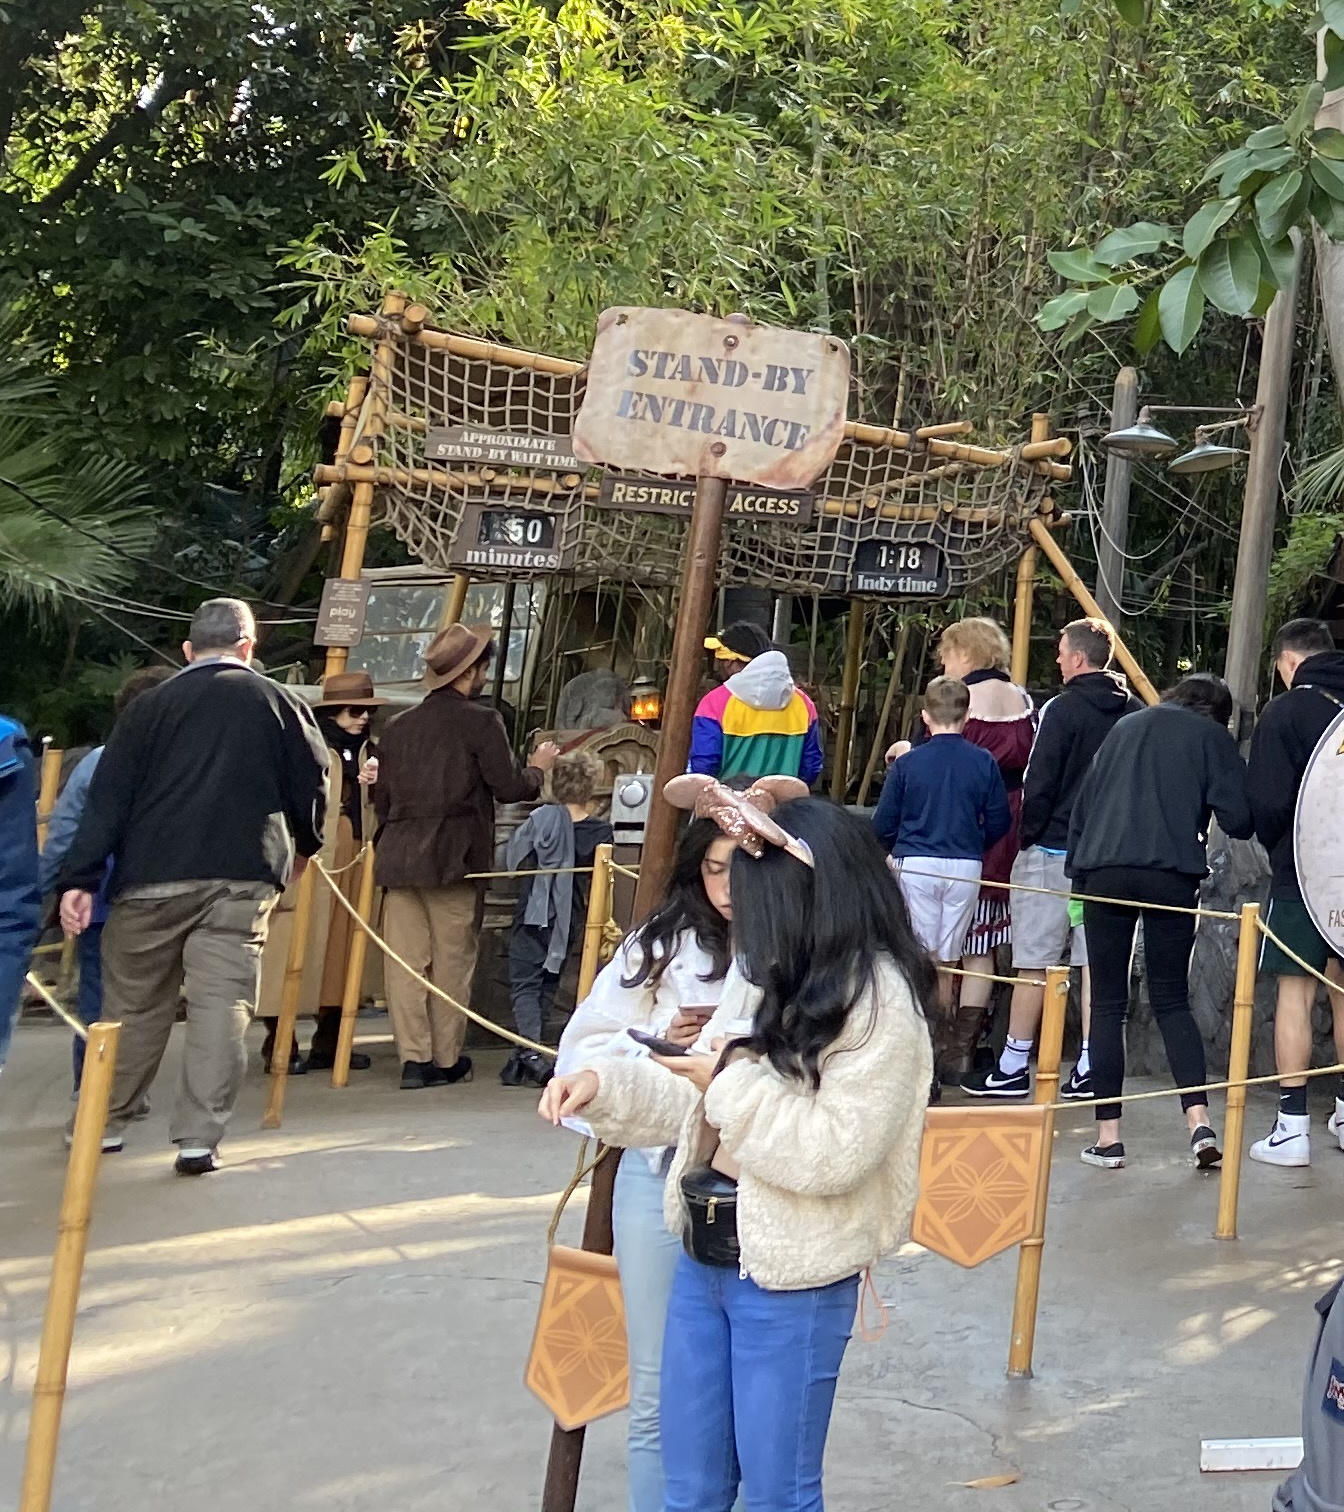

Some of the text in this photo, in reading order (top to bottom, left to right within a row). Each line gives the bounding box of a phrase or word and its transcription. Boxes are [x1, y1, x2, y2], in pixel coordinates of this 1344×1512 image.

[627, 349, 815, 395] STAND-BY
[616, 390, 811, 451] ENTRANCE
[459, 431, 556, 451] APPROXIMATE
[437, 444, 578, 468] STAND-BY WAIT TIME
[730, 492, 800, 515] ACCESS
[466, 548, 559, 569] minutes
[880, 546, 921, 569] 1:18
[857, 574, 938, 593] Indy time
[330, 606, 356, 619] play
